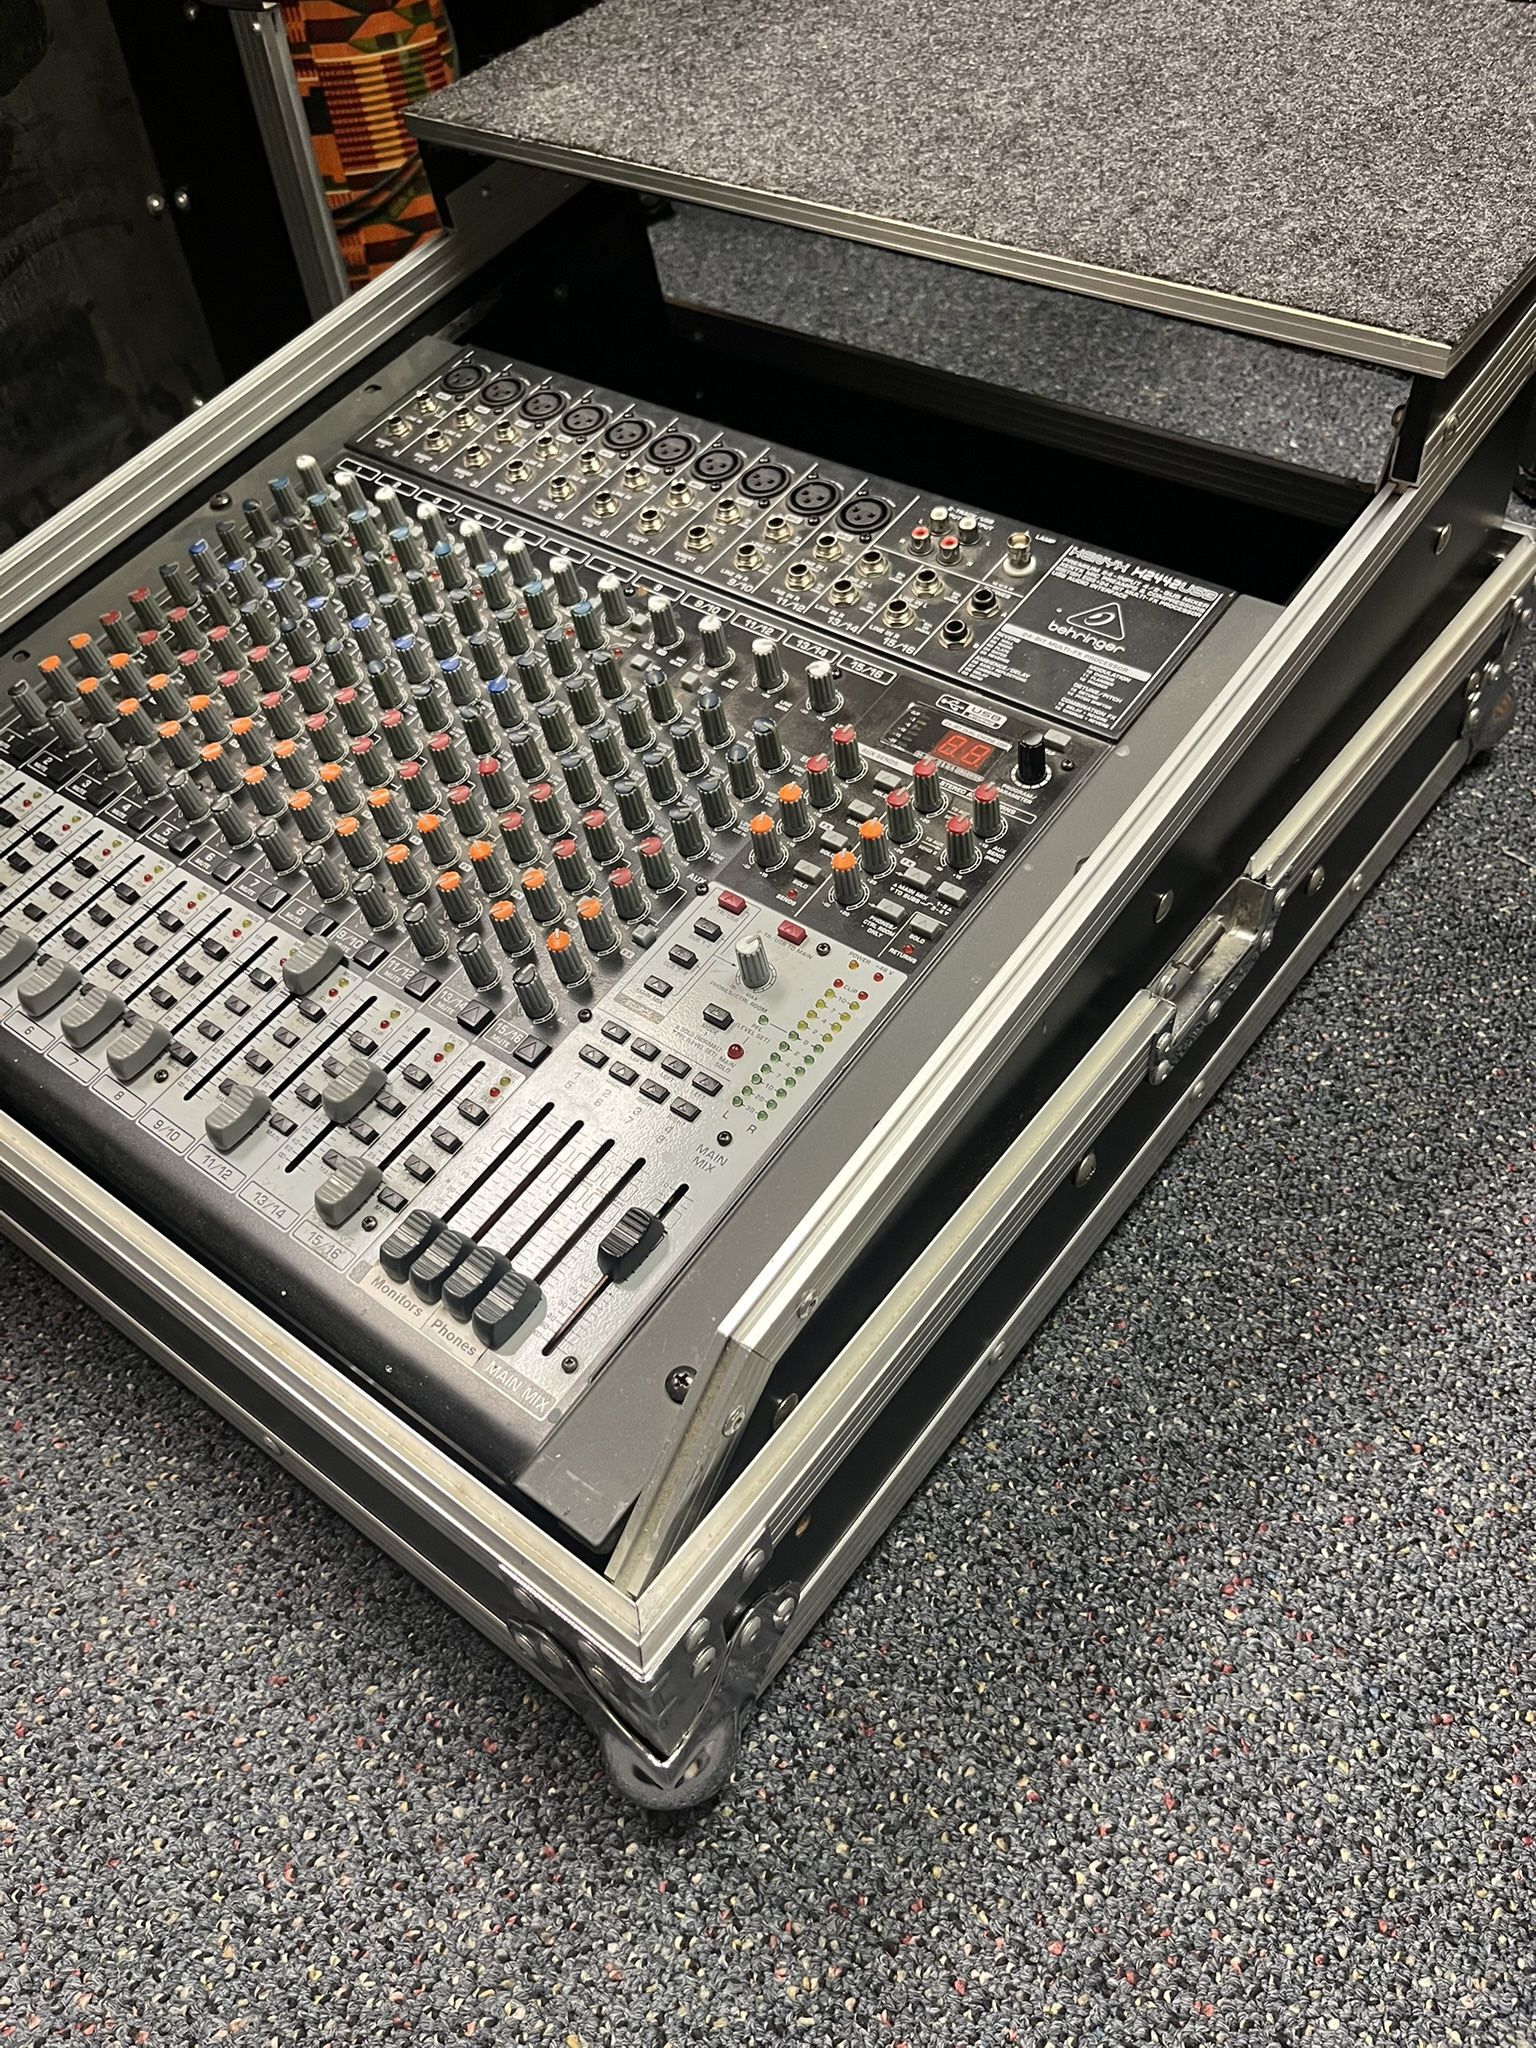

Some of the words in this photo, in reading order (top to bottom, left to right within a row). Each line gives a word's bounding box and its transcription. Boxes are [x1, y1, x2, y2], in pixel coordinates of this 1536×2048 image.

[607, 565, 616, 573] 7
[727, 578, 752, 593] 9/10
[694, 600, 721, 615] 9/10
[776, 597, 804, 613] 11/12
[744, 619, 772, 636] 11/12
[827, 616, 858, 634] 13/14
[1048, 620, 1126, 653] behringer
[796, 639, 828, 658] 13/14
[882, 637, 916, 655] 15/16
[850, 659, 883, 679] 15/16
[1084, 654, 1128, 673] PROCESSOR
[971, 706, 1002, 722] USB
[43, 757, 53, 765] 2
[82, 780, 92, 788] 3
[939, 780, 966, 794] STEREO
[1001, 784, 1037, 800] PROGRAM/
[121, 804, 132, 812] 4
[163, 828, 173, 836] 5
[205, 853, 216, 862] 6
[986, 850, 1005, 860] SEND
[992, 846, 1008, 855] AUX
[194, 858, 212, 870] MUTE
[250, 879, 261, 887] 7
[686, 872, 708, 884] AUX
[792, 879, 809, 889] SOLO
[238, 884, 256, 897] MUTE
[898, 884, 916, 896] MAIN
[916, 891, 930, 901] MIX
[775, 893, 797, 907] SENDS
[296, 906, 307, 915] 8
[285, 912, 303, 924] MUTE
[869, 915, 898, 931] PHONES/
[863, 919, 878, 930] CTRL
[878, 925, 896, 937] ROOM
[867, 927, 884, 938] ONLY
[335, 930, 364, 949] 9/10
[908, 933, 926, 945] SOLO
[796, 948, 813, 960] MAIN
[848, 951, 872, 966] POWER
[888, 947, 917, 964] RETURNS
[386, 958, 414, 980] 11/12
[385, 970, 402, 984] MUTE
[843, 984, 858, 994] CLIP
[436, 1002, 454, 1016] MUTE
[750, 1000, 768, 1014] ROOM
[25, 1026, 34, 1035] 6
[495, 1021, 524, 1044] 15/16
[751, 1023, 761, 1032] PFL
[491, 1034, 510, 1049] MUTE
[69, 1057, 79, 1066] 7
[714, 1061, 731, 1073] SOLO
[720, 1056, 737, 1069] MAIN
[114, 1091, 125, 1100] 8
[722, 1110, 729, 1119] L
[153, 1120, 181, 1142] 9/10
[266, 1129, 280, 1141] MAIN
[747, 1124, 757, 1134] R
[695, 1144, 728, 1166] MAIN
[202, 1153, 233, 1180] 11/12
[692, 1156, 715, 1173] MIX
[254, 1191, 287, 1220] 13/14
[375, 1204, 390, 1217] MAIN
[307, 1230, 341, 1259] 15/16
[370, 1276, 425, 1317] Monitors
[430, 1319, 477, 1356] Phones
[486, 1361, 520, 1392] MAIN
[522, 1386, 551, 1412] MIX
